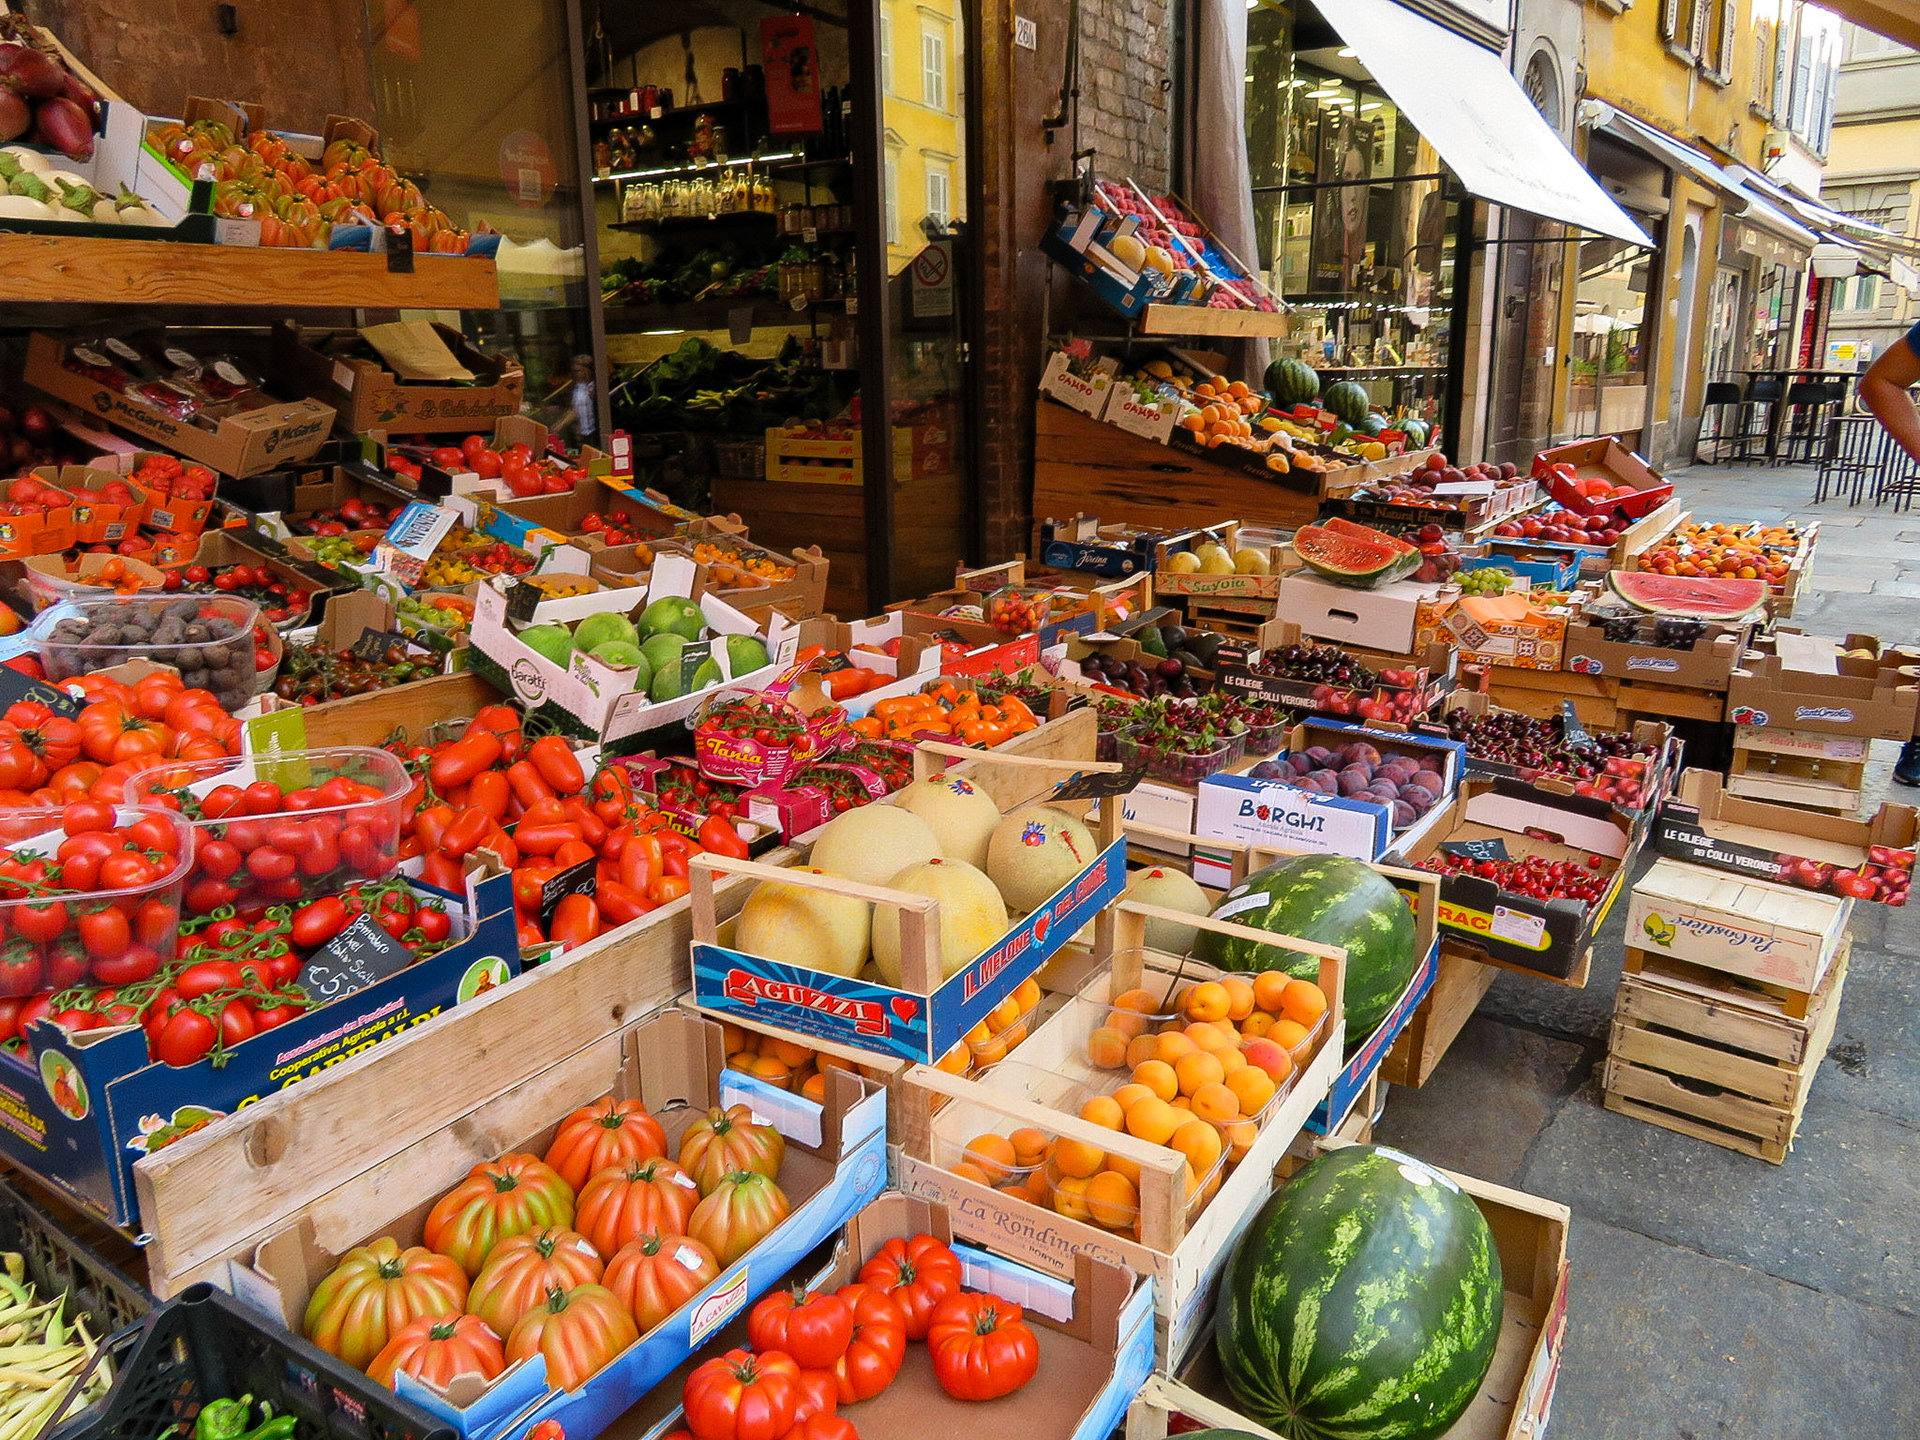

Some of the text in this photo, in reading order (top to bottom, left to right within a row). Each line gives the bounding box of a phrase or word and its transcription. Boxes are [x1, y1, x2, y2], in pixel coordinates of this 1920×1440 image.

[1224, 675, 1234, 685] LE
[1258, 691, 1281, 703] COLLI
[1281, 696, 1318, 709] VERONESI
[706, 737, 764, 765] Tania
[1664, 829, 1715, 849] LE CILIEGIE
[1706, 849, 1734, 863] COLLI
[1734, 854, 1782, 875] VERONESI
[962, 857, 1108, 1000] IL MELONE DEL CUORE
[741, 976, 868, 1020] AGUZZI
[269, 1043, 340, 1081] Cooperativa
[341, 1021, 386, 1049] Agricola
[387, 1017, 396, 1026] a
[958, 1197, 986, 1220] La
[692, 1285, 747, 1335] LA CAVAZZA
